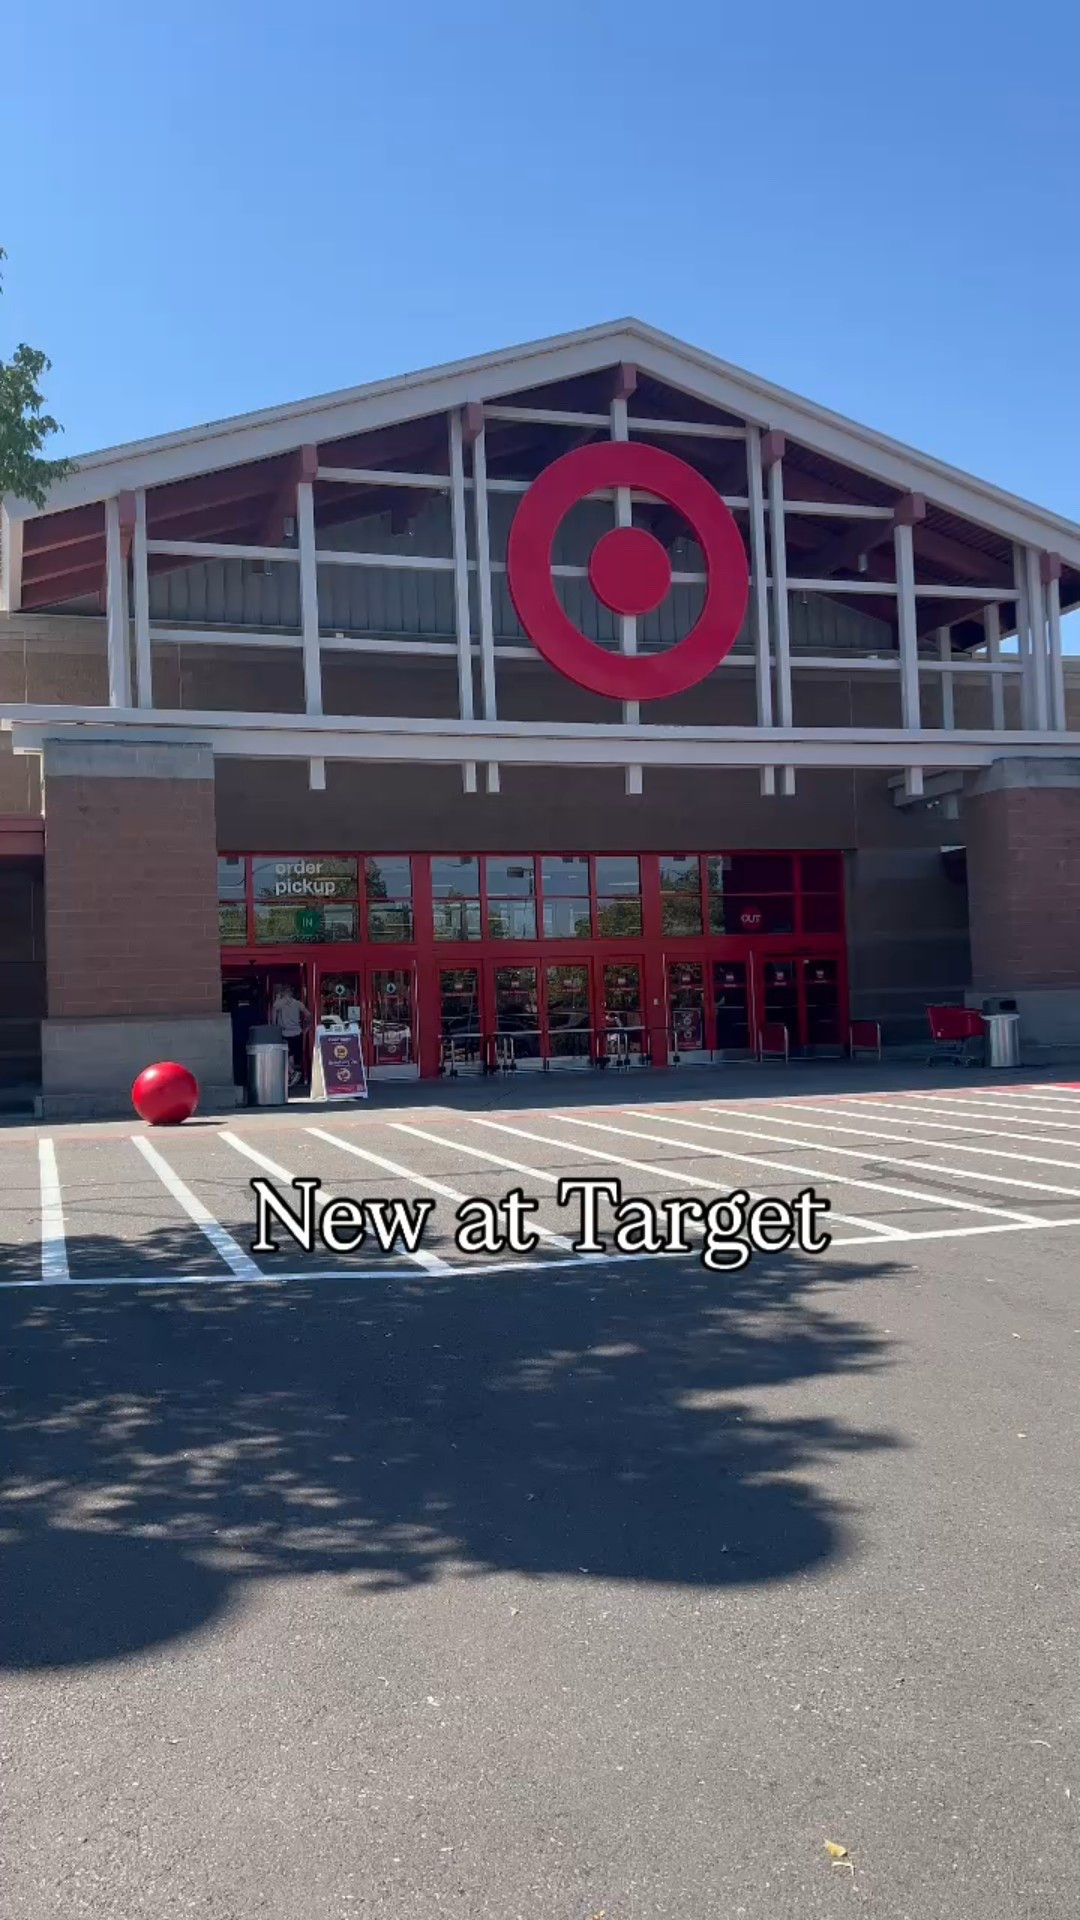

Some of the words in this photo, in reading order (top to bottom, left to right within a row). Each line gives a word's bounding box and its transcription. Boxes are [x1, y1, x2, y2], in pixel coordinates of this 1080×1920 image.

[275, 860, 323, 874] order
[275, 879, 335, 896] pickup
[302, 917, 313, 928] IN
[741, 914, 762, 924] OUT
